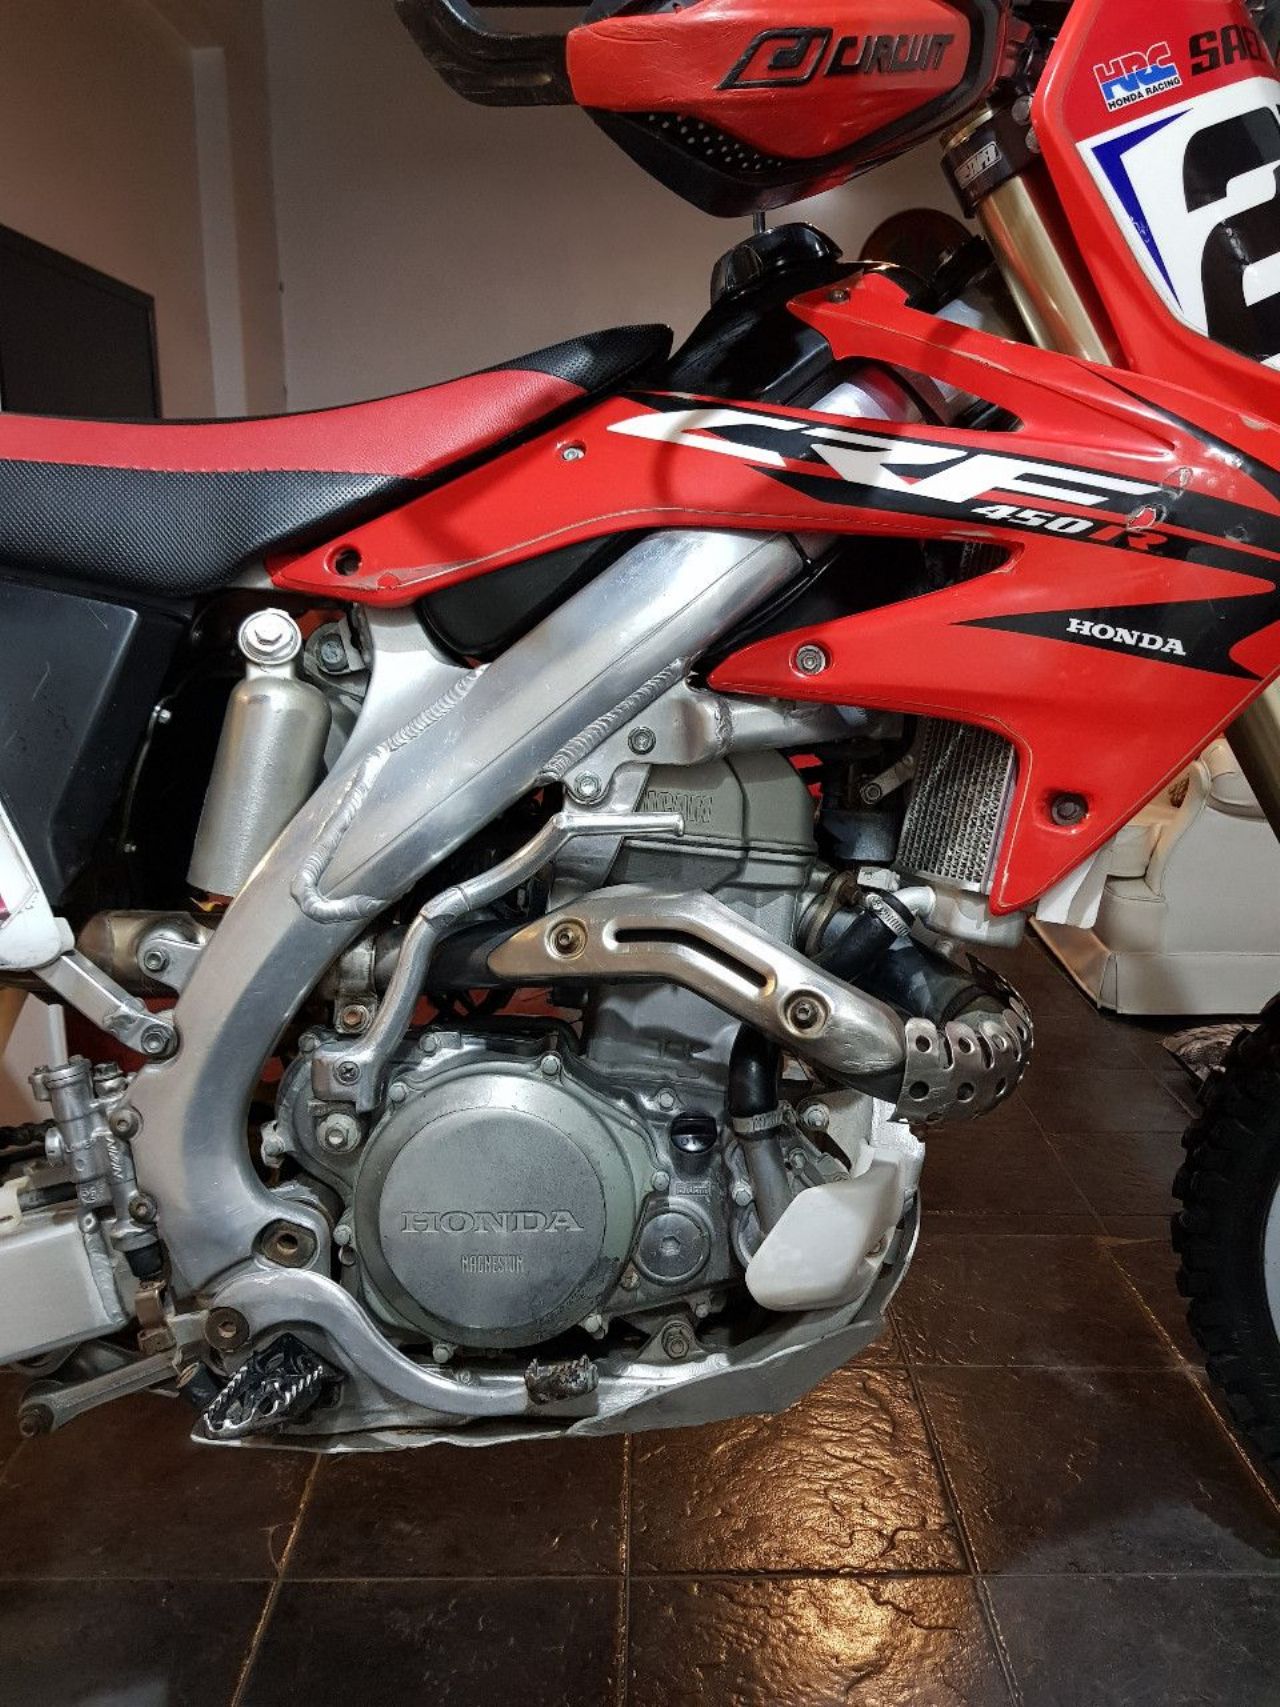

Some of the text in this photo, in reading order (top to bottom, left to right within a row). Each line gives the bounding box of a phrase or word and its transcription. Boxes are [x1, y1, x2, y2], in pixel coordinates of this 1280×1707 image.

[1093, 41, 1178, 101] HRC
[1107, 76, 1181, 110] HONDA RACING
[606, 408, 1168, 505] CRF
[1066, 617, 1187, 657] HONDA
[401, 1209, 585, 1234] HONDA
[460, 1254, 525, 1274] MAGNESIUM
